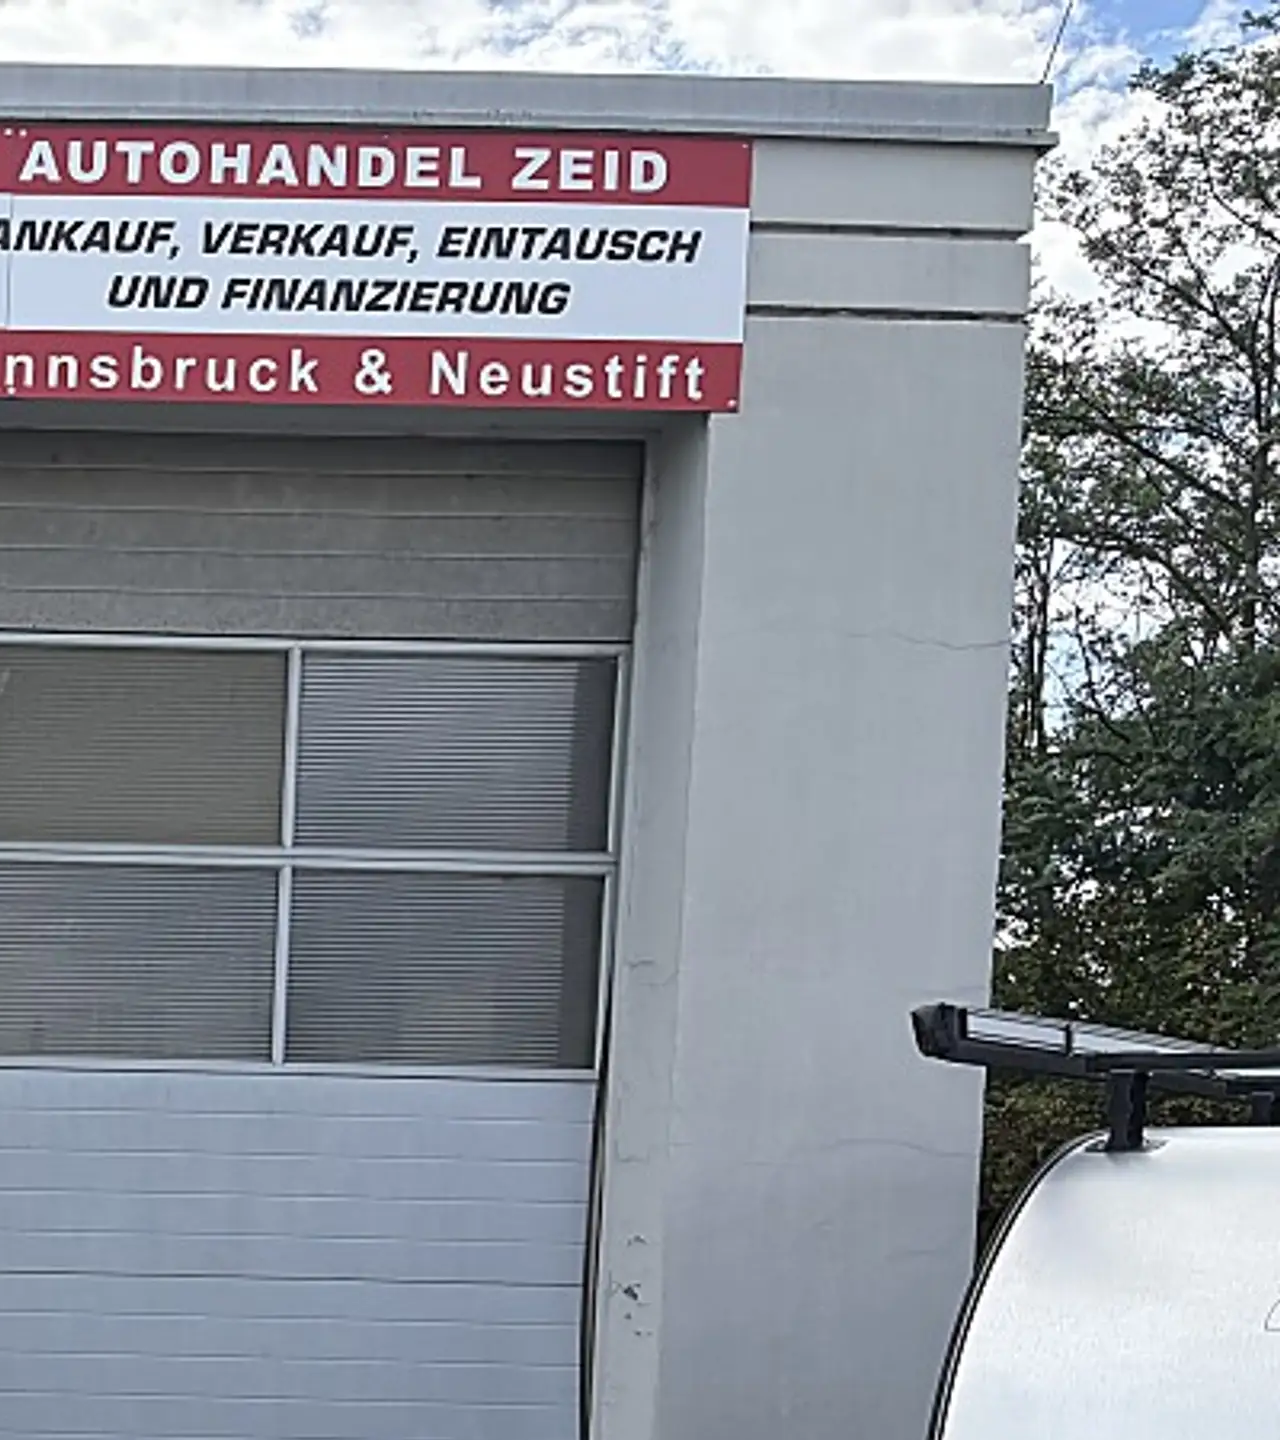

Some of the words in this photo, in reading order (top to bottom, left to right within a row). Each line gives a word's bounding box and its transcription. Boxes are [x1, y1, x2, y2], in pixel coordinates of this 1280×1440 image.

[19, 139, 483, 189] AUTOHANDEL
[512, 147, 670, 193] ZEID
[200, 222, 420, 264] VERKAUF,
[436, 226, 703, 264] EINTAUSCH
[107, 275, 208, 309] UND
[219, 279, 572, 316] FINANZIERUNG
[354, 350, 394, 395] &
[431, 352, 706, 400] Neustift
